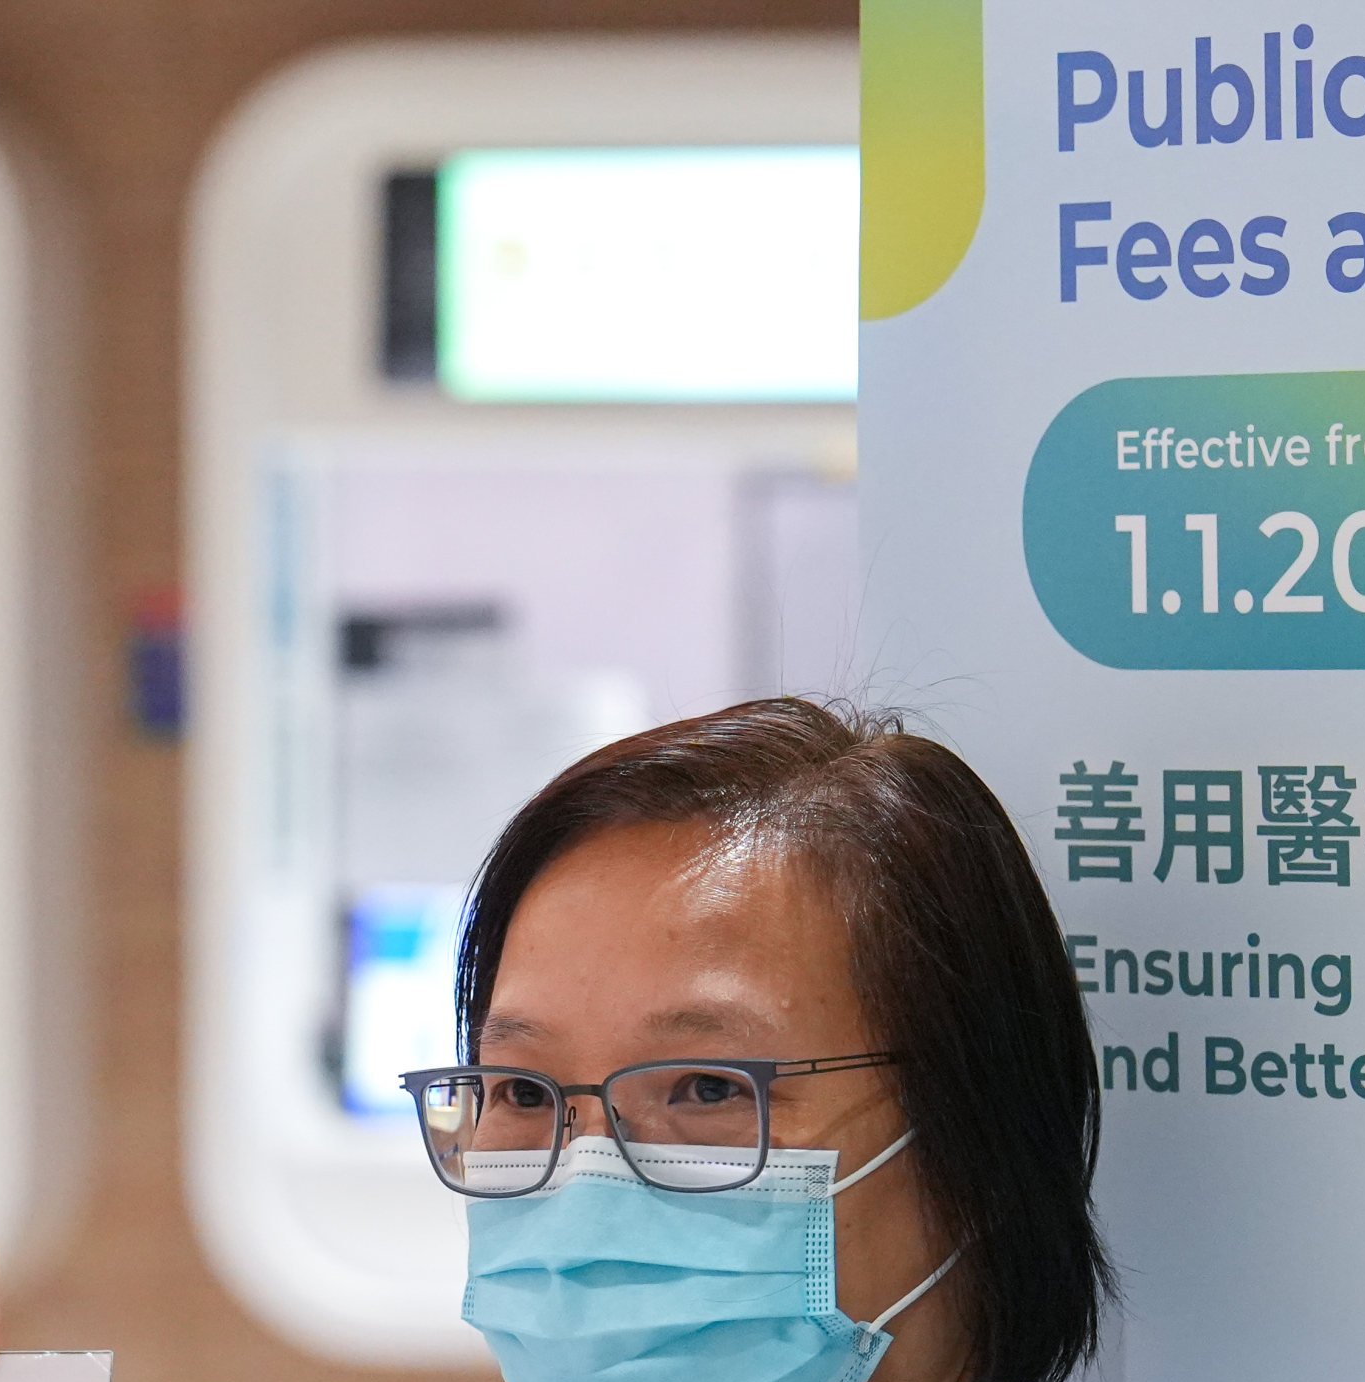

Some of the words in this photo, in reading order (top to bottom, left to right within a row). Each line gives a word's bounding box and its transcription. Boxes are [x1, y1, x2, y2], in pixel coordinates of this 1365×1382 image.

[1058, 201, 1291, 303] Fees
[1114, 424, 1311, 472] Effective
[1066, 933, 1352, 1016] Ensuring
[1103, 1031, 1179, 1093] nd
